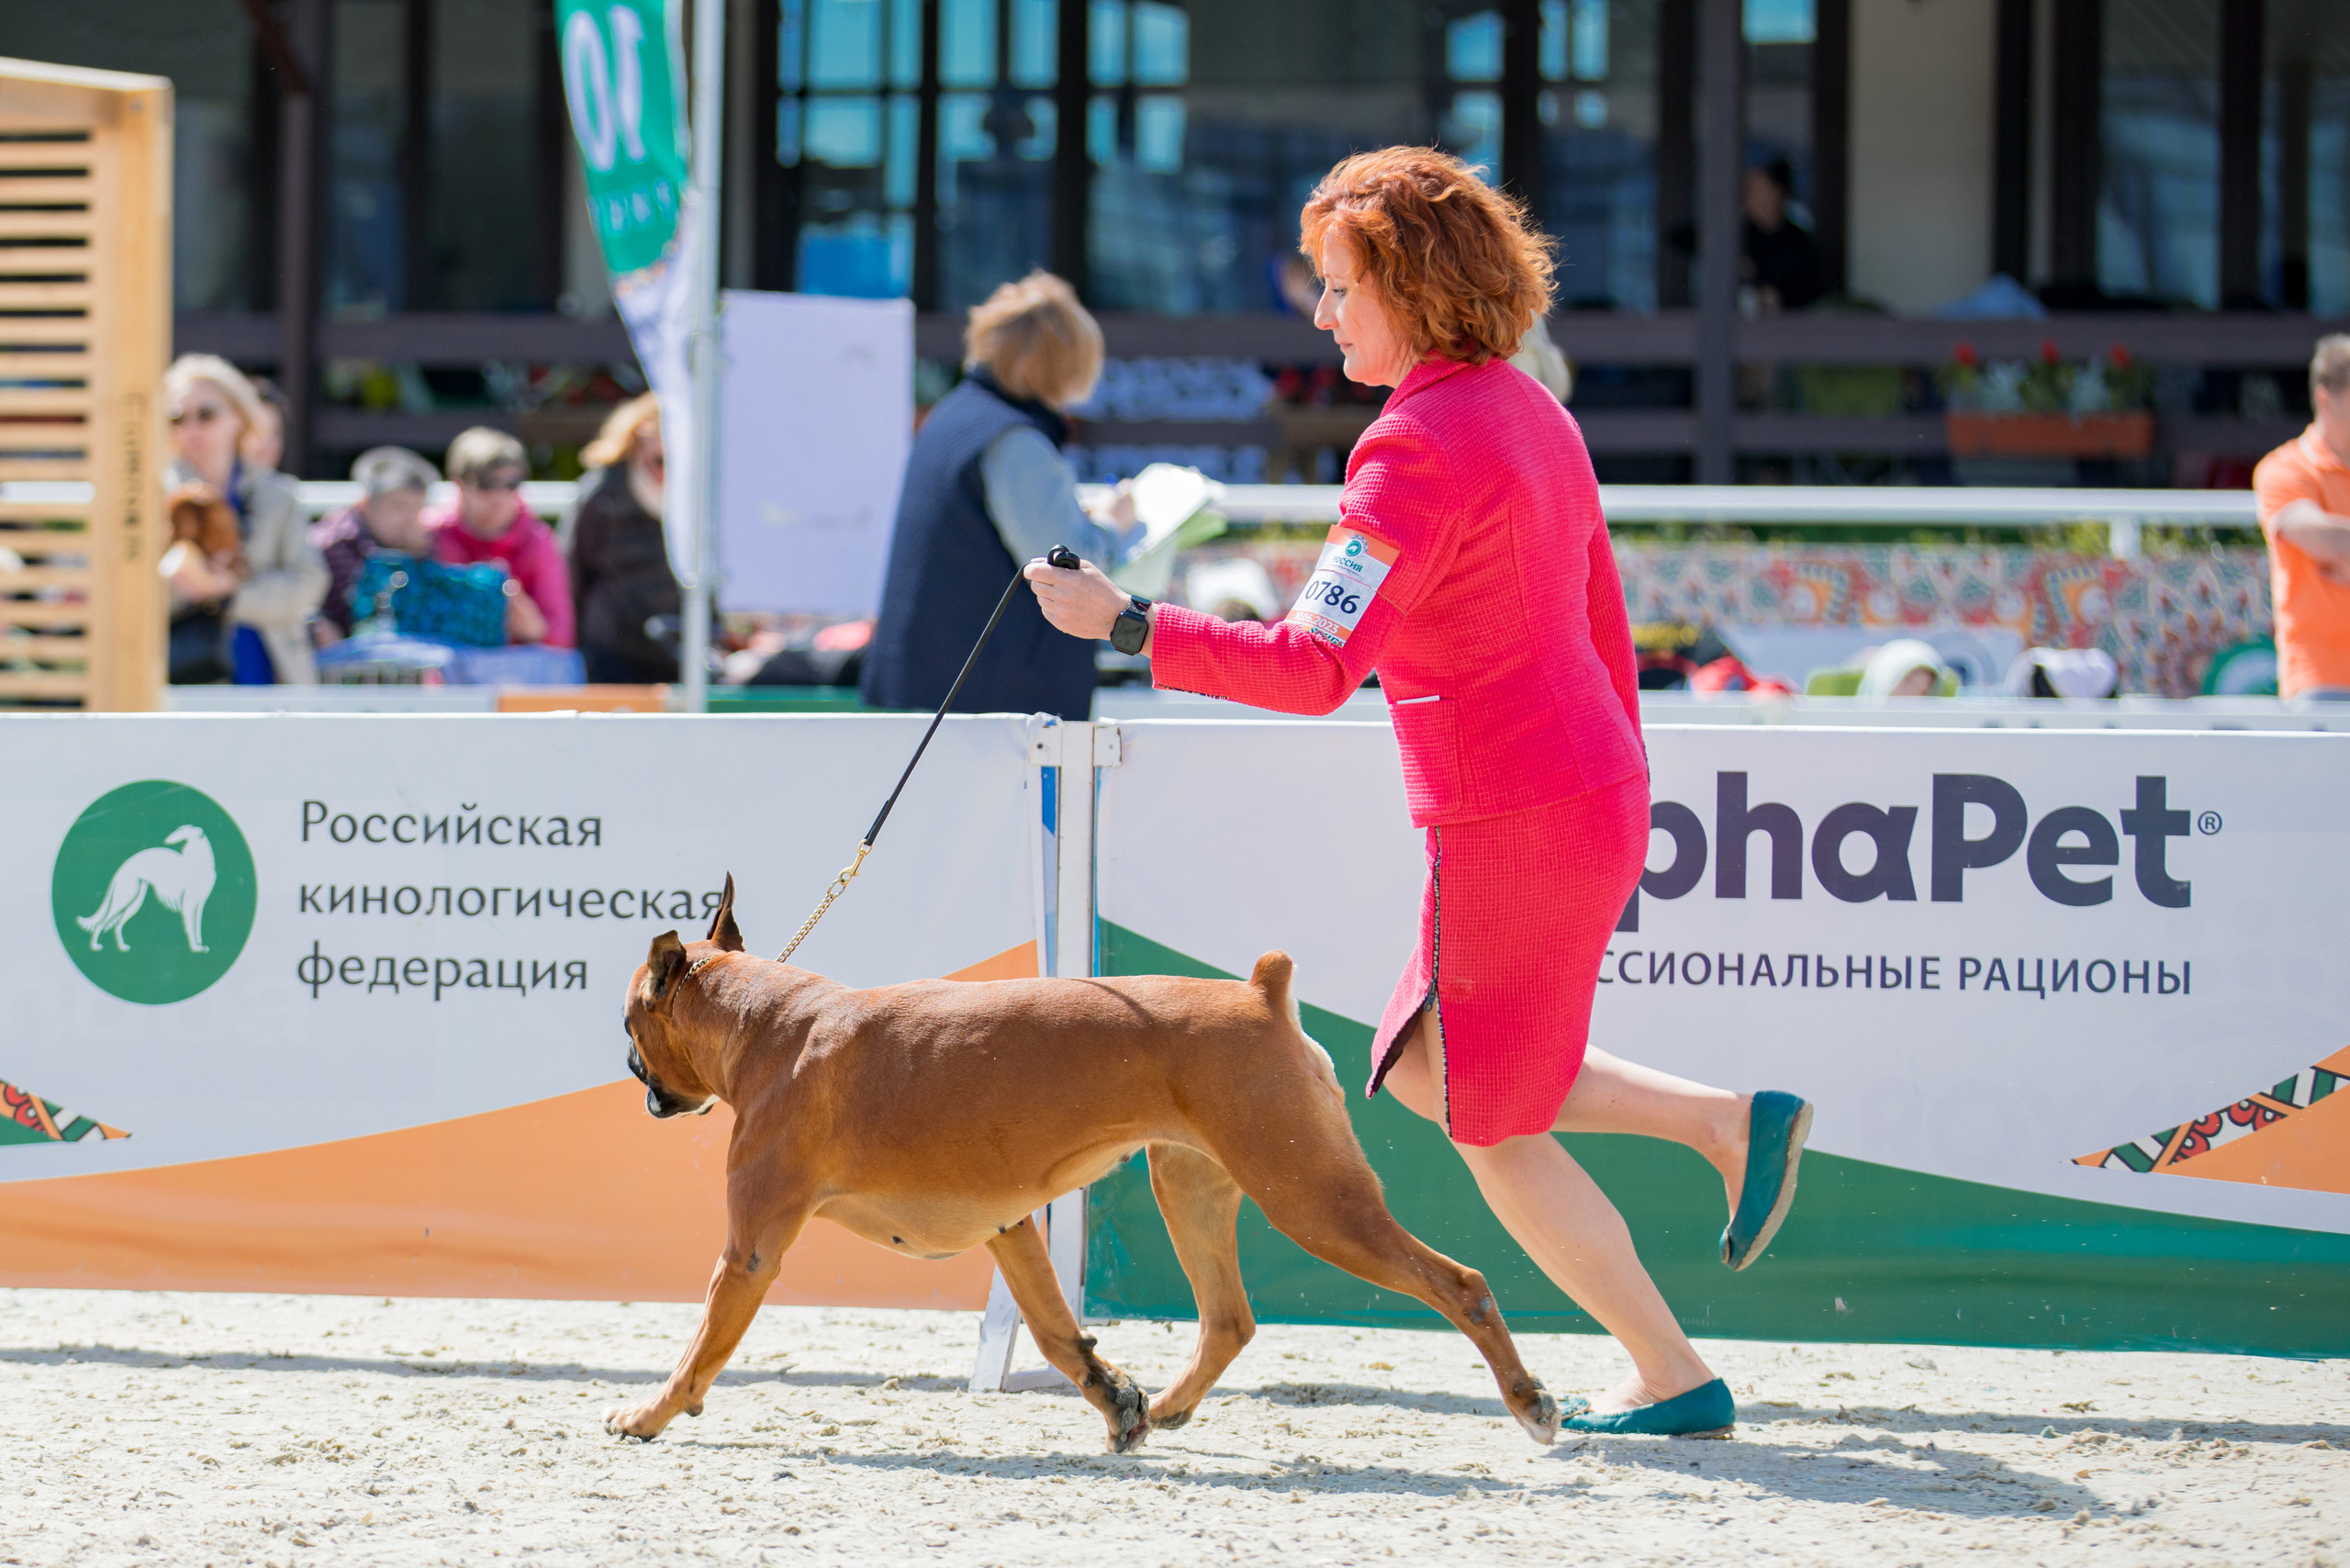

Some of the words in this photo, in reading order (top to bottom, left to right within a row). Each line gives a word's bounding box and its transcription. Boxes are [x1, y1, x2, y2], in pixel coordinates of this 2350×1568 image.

[1305, 580, 1360, 614] 0786
[1294, 612, 1339, 633] 10.06.2023
[302, 801, 601, 846] Российская
[298, 884, 723, 920] кинологическая
[297, 940, 588, 1002] федерация
[1959, 957, 2190, 1000] РАЦИОНЫ
